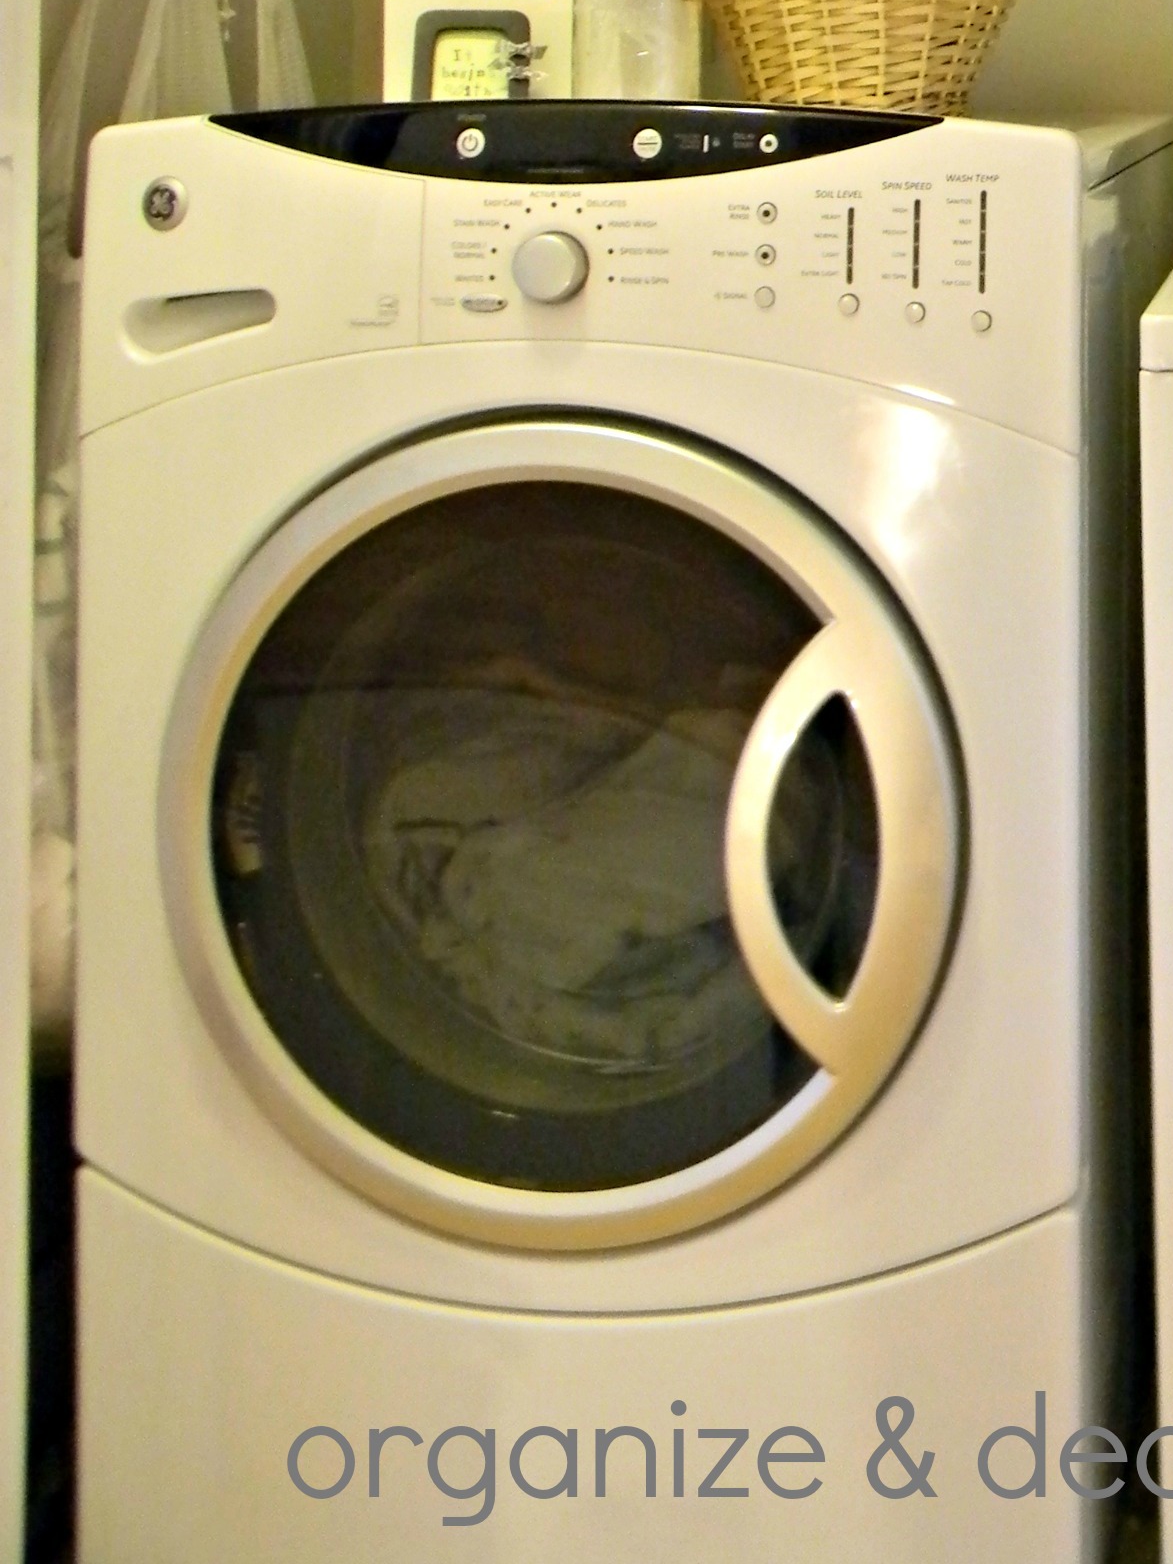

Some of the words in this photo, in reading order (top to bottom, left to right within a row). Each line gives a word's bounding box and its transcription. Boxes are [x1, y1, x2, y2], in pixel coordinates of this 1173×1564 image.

[945, 173, 973, 184] WASH
[975, 173, 1000, 184] TEMP
[881, 181, 903, 191] SPIN
[904, 181, 932, 191] SPEED
[814, 189, 835, 199] SOIL
[836, 189, 863, 199] LEVEL
